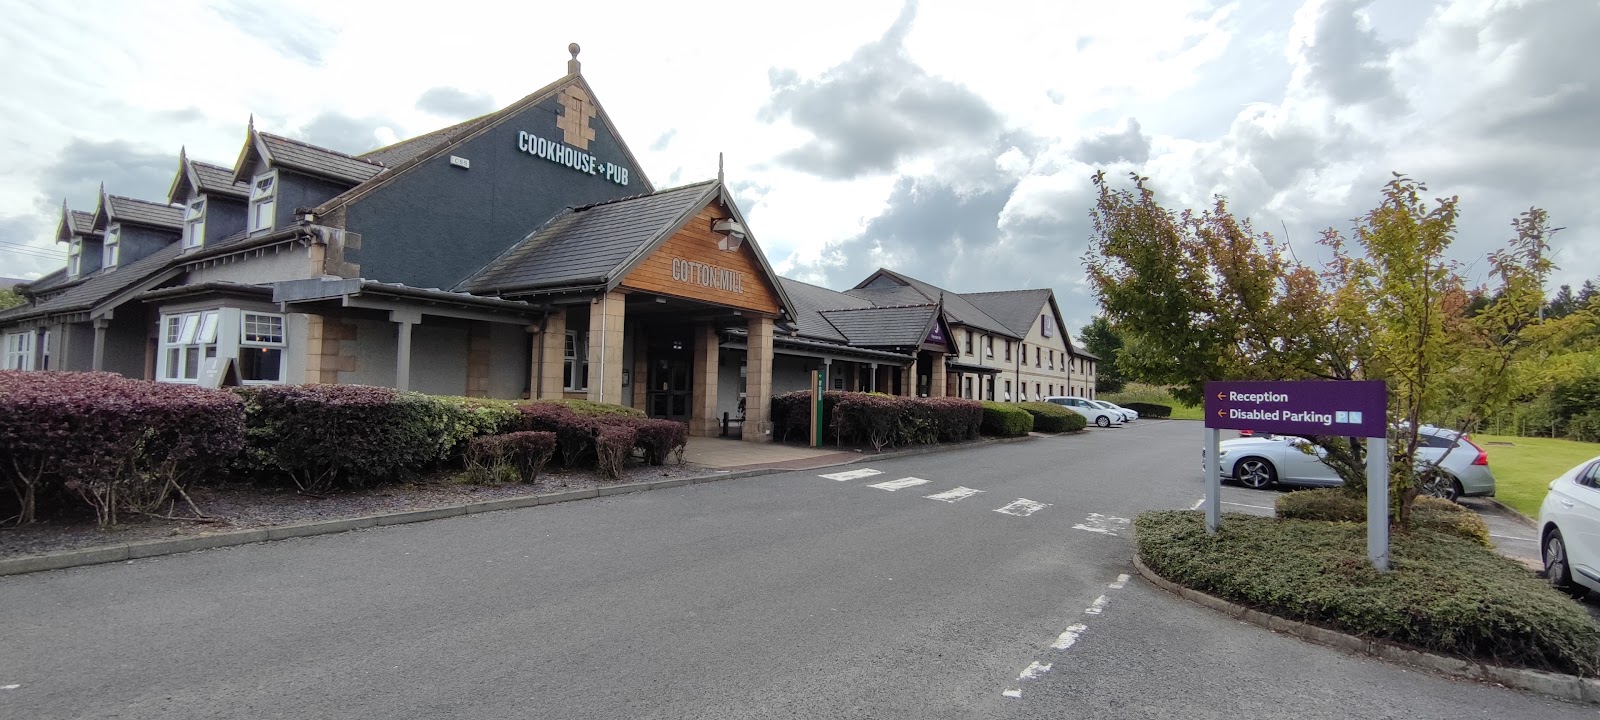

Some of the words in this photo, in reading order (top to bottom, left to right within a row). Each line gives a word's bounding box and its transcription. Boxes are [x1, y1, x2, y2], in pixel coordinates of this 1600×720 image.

[518, 131, 597, 175] COOKHOUSE
[606, 162, 629, 186] PUB
[672, 257, 718, 289] COTTON
[719, 269, 744, 294] MILL
[1229, 391, 1289, 404] Reception
[1229, 408, 1280, 421] Disabled
[1282, 411, 1332, 426] Parking
